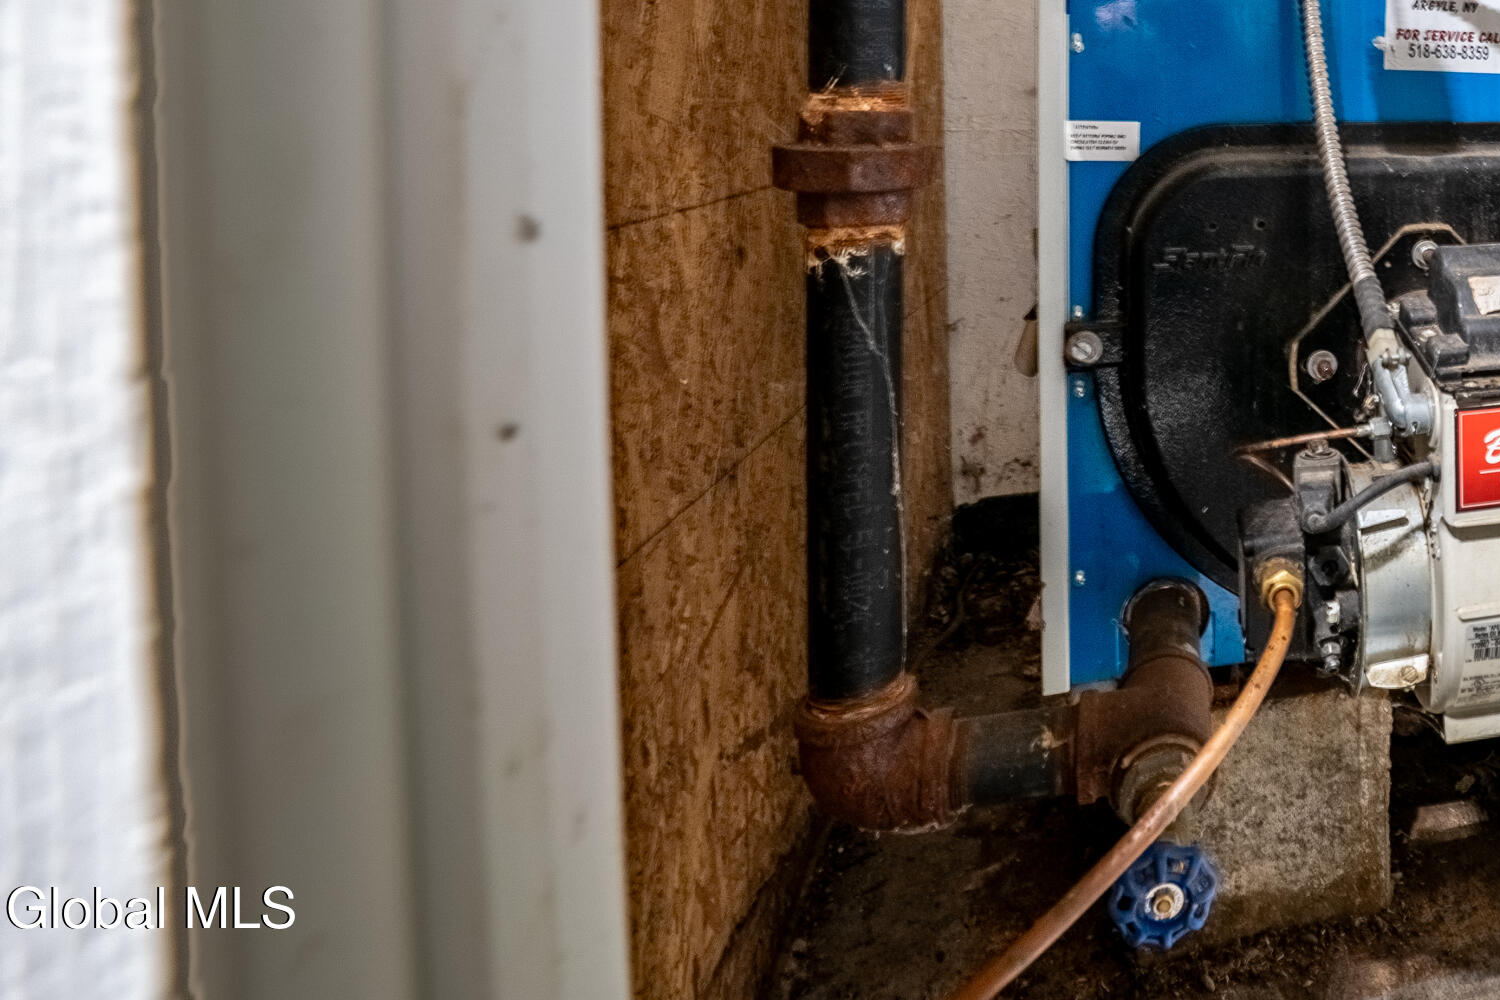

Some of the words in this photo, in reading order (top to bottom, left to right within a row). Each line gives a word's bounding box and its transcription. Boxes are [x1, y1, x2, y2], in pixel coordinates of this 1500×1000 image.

[1462, 1, 1479, 13] NY
[1396, 28, 1420, 41] FOR
[1423, 29, 1475, 43] SERVICE
[1408, 43, 1490, 60] 518-638-8359
